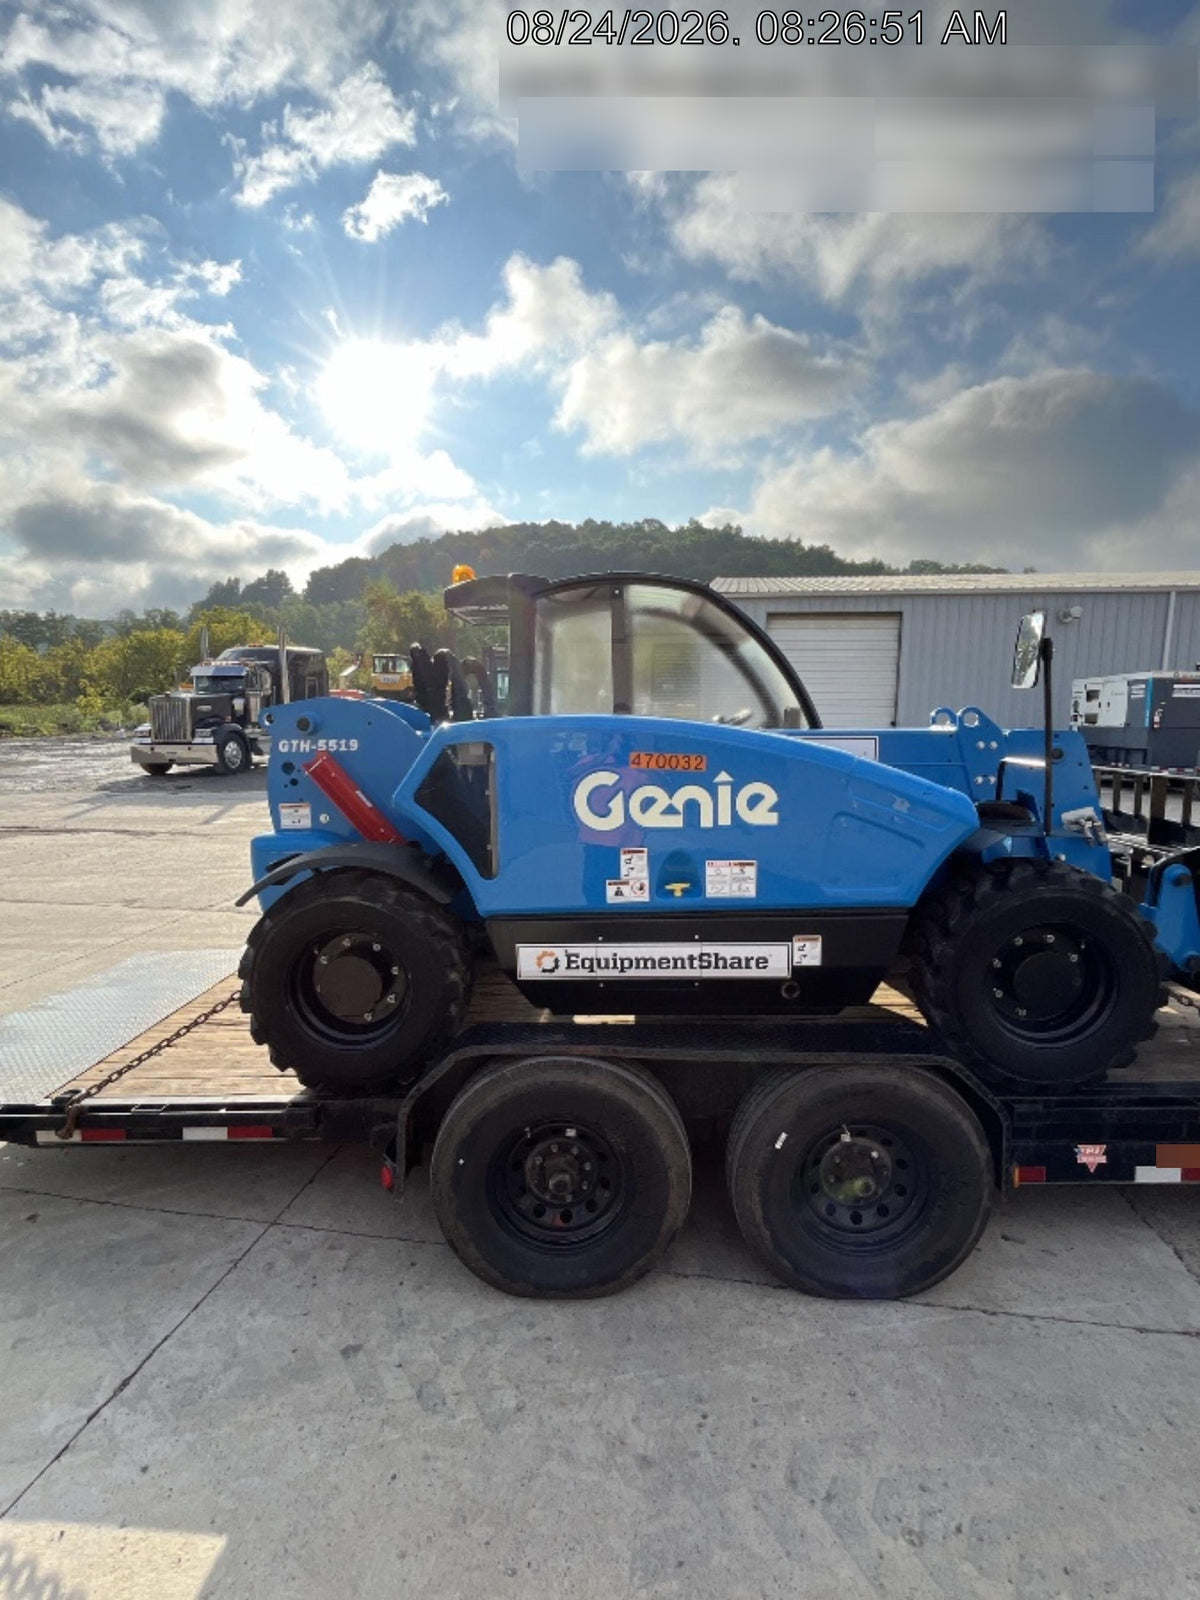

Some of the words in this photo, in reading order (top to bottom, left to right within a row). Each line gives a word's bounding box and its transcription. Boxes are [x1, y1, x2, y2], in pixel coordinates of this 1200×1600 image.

[278, 739, 359, 753] GTH-5519
[631, 753, 704, 770] 470032
[574, 770, 779, 831] Genie
[564, 951, 769, 973] EquipmentShare
